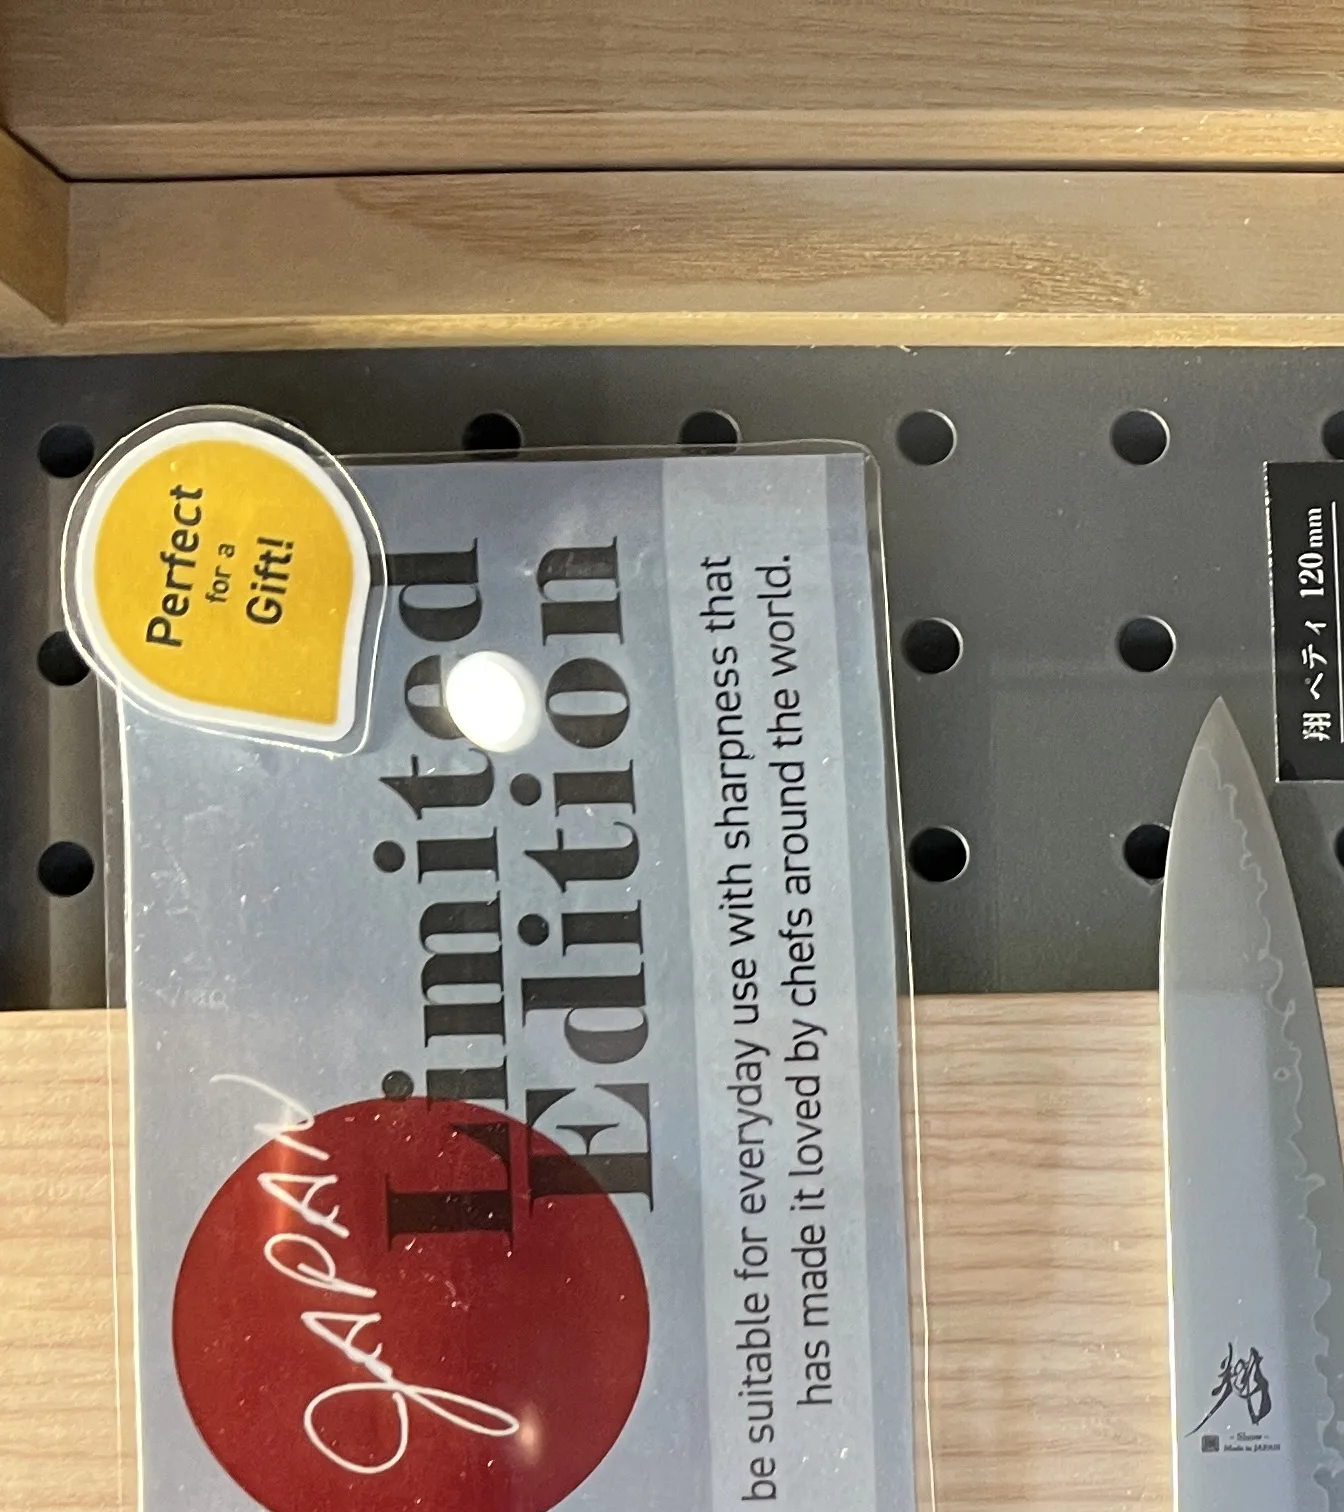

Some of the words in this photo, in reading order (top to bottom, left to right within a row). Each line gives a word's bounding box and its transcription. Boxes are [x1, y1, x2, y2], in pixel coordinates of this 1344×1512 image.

[146, 484, 203, 648] Perfect
[205, 565, 232, 603] for
[218, 543, 236, 559] a
[246, 537, 294, 625] Gift!
[700, 555, 736, 633] that
[755, 555, 798, 677] world.
[1302, 620, 1328, 700] ペティ
[713, 646, 756, 850] sharpness
[767, 688, 803, 749] the
[1303, 712, 1332, 742] 翔
[769, 761, 812, 895] around
[508, 534, 654, 1213] Edition
[717, 863, 756, 947] with
[732, 958, 760, 1025] use
[779, 908, 817, 1007] chefs
[784, 1019, 828, 1062] by
[727, 1038, 773, 1215] everyday
[785, 1075, 824, 1177] loved
[790, 1187, 826, 1211] it
[209, 1072, 518, 1474] JAPAN
[734, 1226, 769, 1281] for
[791, 1224, 829, 1327] made
[735, 1292, 775, 1444] suitable
[797, 1339, 833, 1406] has
[741, 1456, 777, 1501] be
